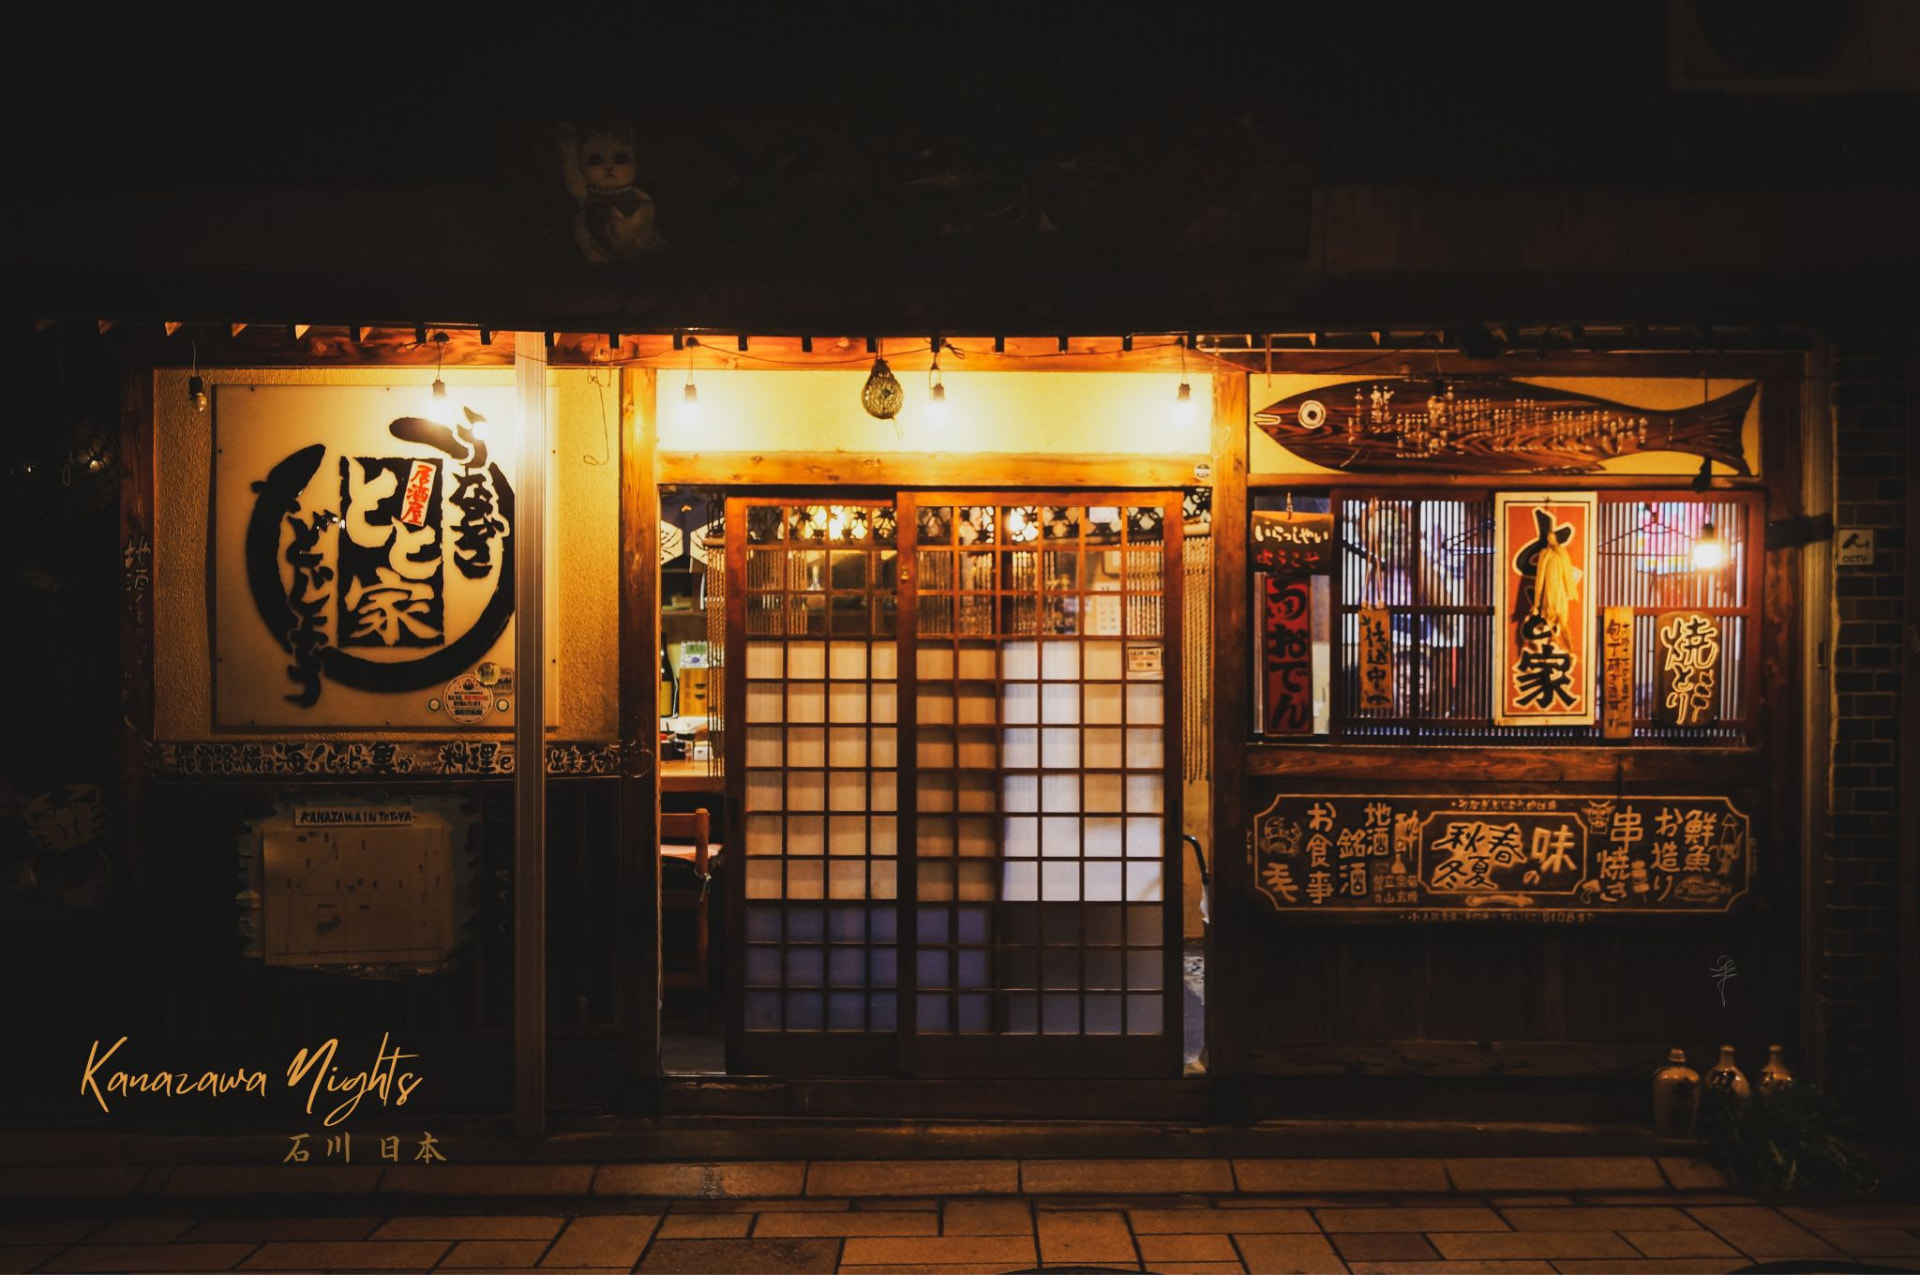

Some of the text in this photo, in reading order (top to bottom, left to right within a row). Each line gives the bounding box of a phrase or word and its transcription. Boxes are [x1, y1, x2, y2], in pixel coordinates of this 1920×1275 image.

[400, 465, 433, 524] 居酒屋
[342, 457, 444, 647] とと家
[1255, 522, 1328, 544] いらっしゃい
[1256, 551, 1320, 569] ようこそ
[300, 811, 360, 823] KANAZAWA
[1364, 802, 1392, 855] 地酒
[1684, 809, 1717, 873] 鮮魚
[1305, 802, 1337, 904] お食事
[1336, 827, 1367, 896] 銘酒
[1596, 805, 1643, 902] 串焼き
[1650, 807, 1684, 902] お造り
